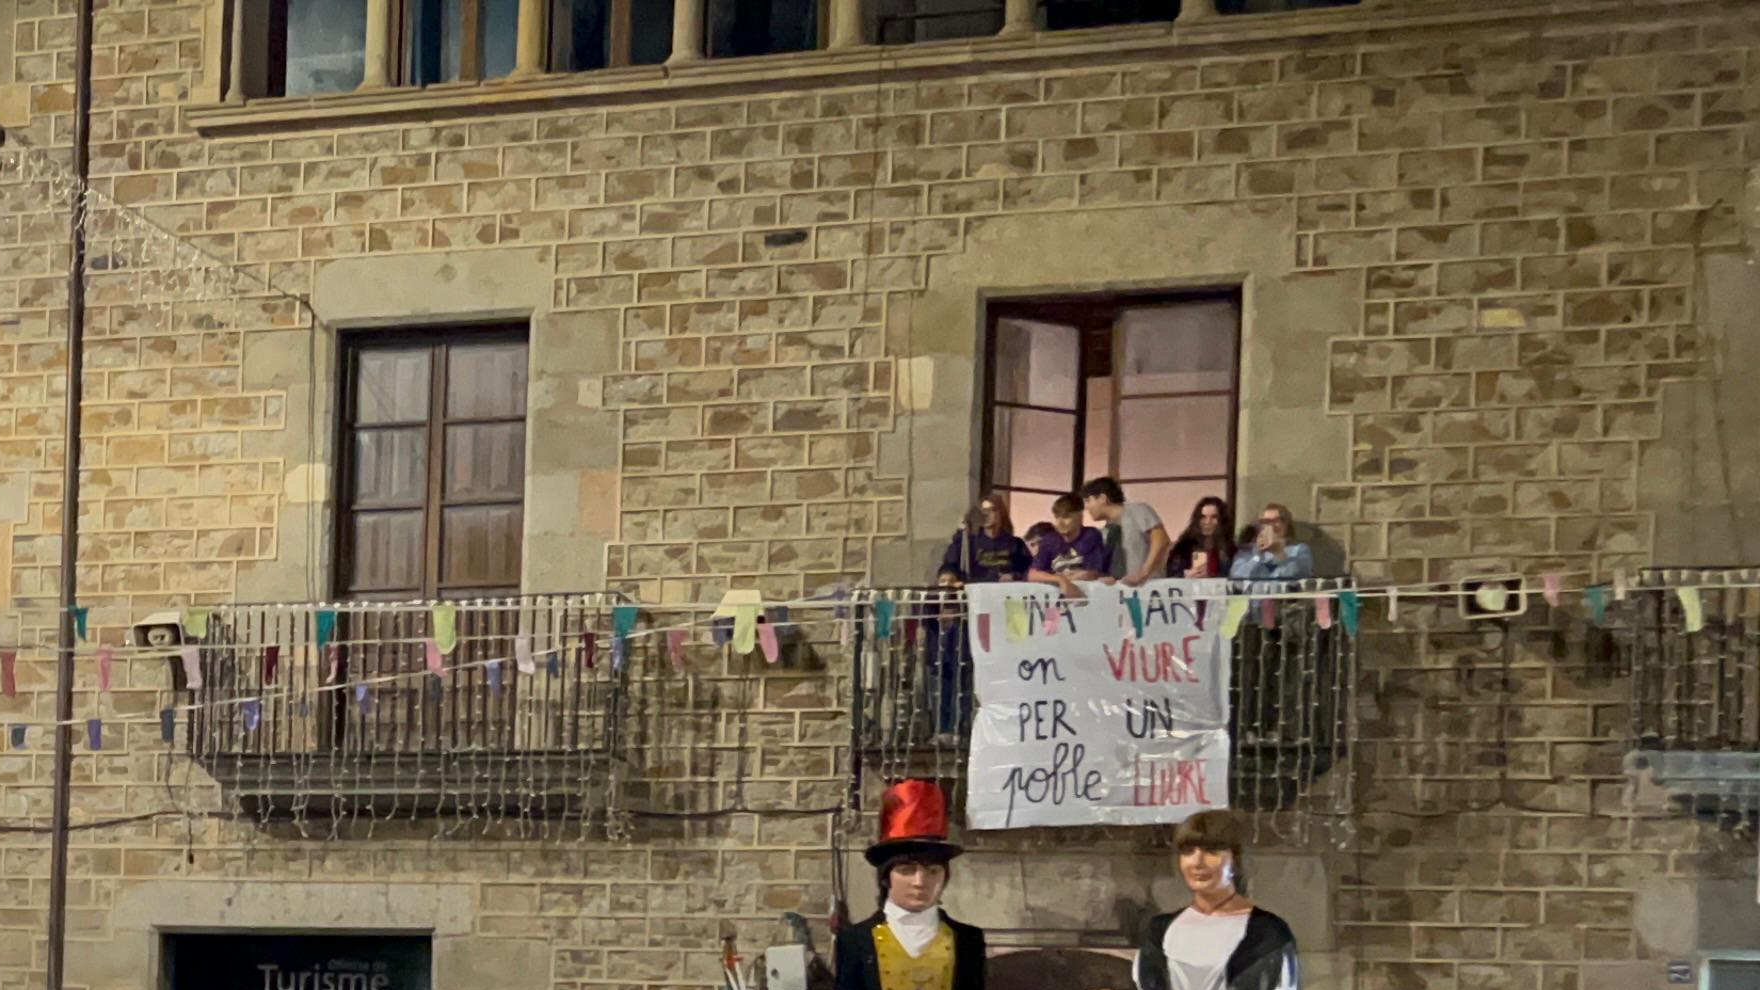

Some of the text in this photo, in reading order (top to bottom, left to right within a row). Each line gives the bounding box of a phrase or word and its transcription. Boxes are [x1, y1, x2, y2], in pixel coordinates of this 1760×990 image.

[1004, 593, 1077, 636] NA
[1017, 657, 1066, 685] on
[1019, 697, 1174, 742] PER UN
[1002, 743, 1102, 828] poble
